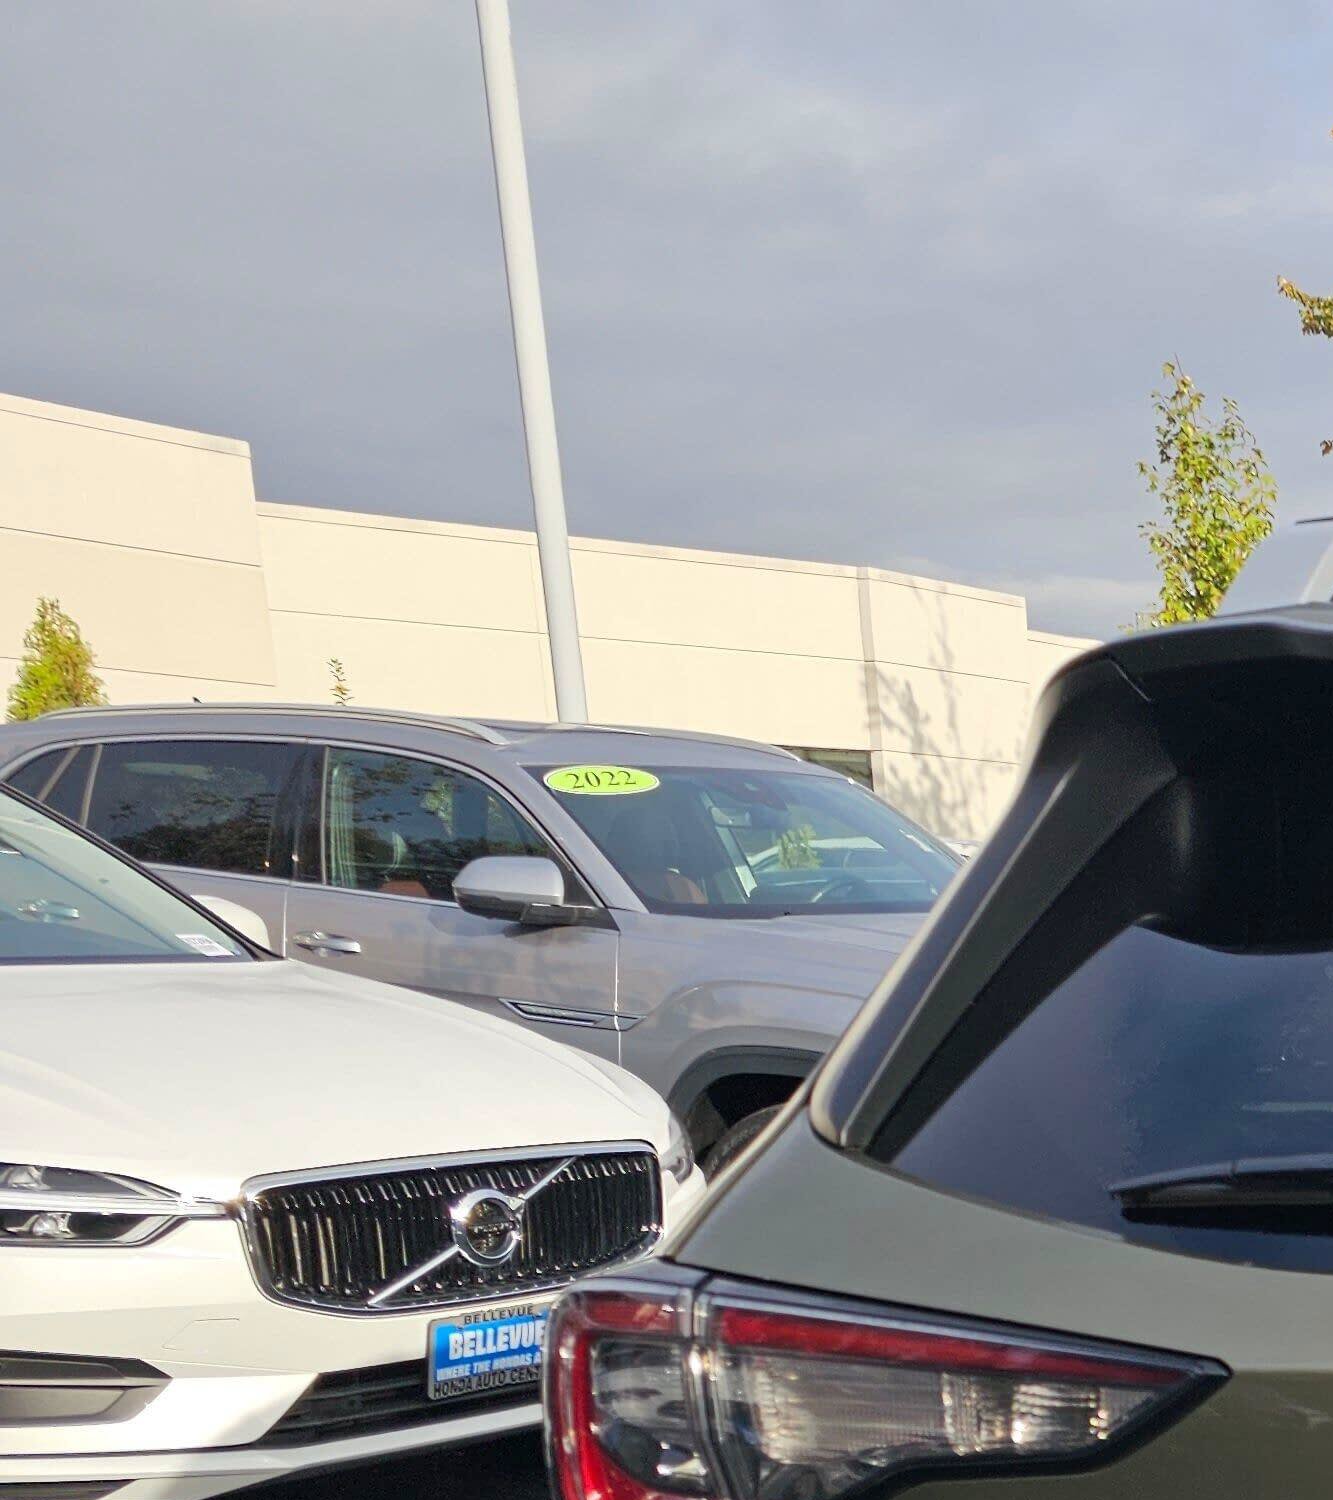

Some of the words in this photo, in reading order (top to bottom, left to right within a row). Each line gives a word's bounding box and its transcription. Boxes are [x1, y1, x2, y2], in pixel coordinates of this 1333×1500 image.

[564, 770, 637, 789] 2022
[464, 1305, 534, 1325] BELLEVUE
[448, 1320, 547, 1361] BELLEVUE
[433, 1376, 473, 1399] HONDA
[475, 1369, 507, 1390] AUTO
